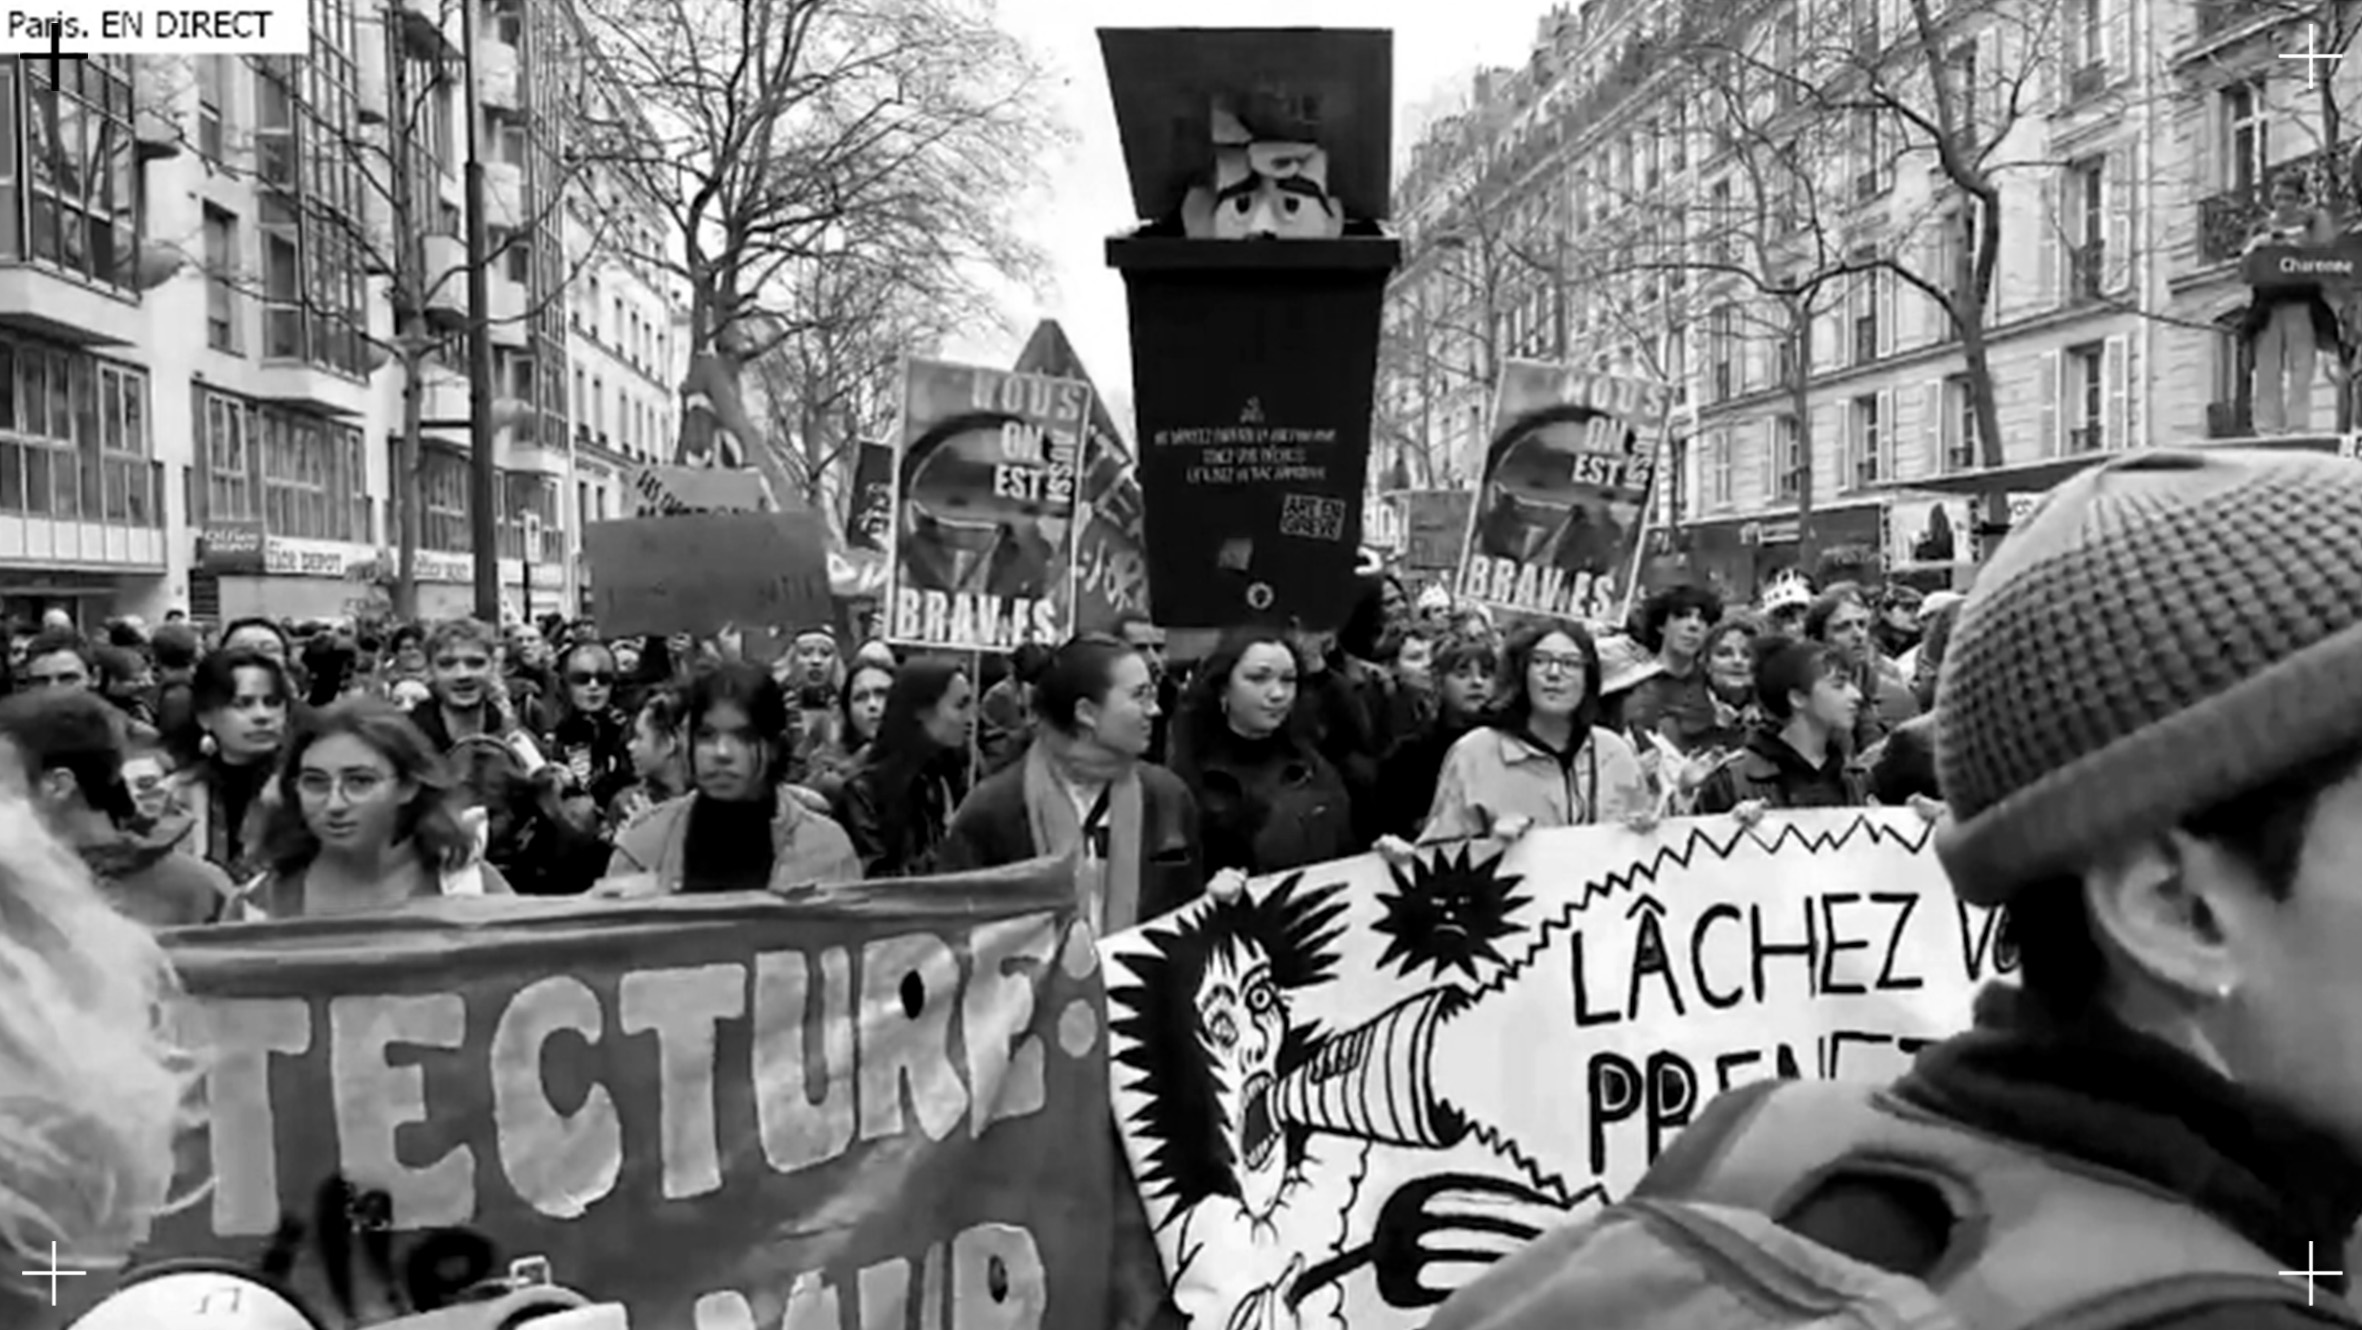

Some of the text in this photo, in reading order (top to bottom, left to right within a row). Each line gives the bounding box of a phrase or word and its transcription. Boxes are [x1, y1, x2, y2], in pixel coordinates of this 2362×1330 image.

[1001, 421, 1047, 461] ON
[1586, 416, 1629, 454] ON
[994, 463, 1043, 500] EST
[1572, 454, 1624, 486] EST
[1571, 893, 1923, 1026] LÂCHEZ
